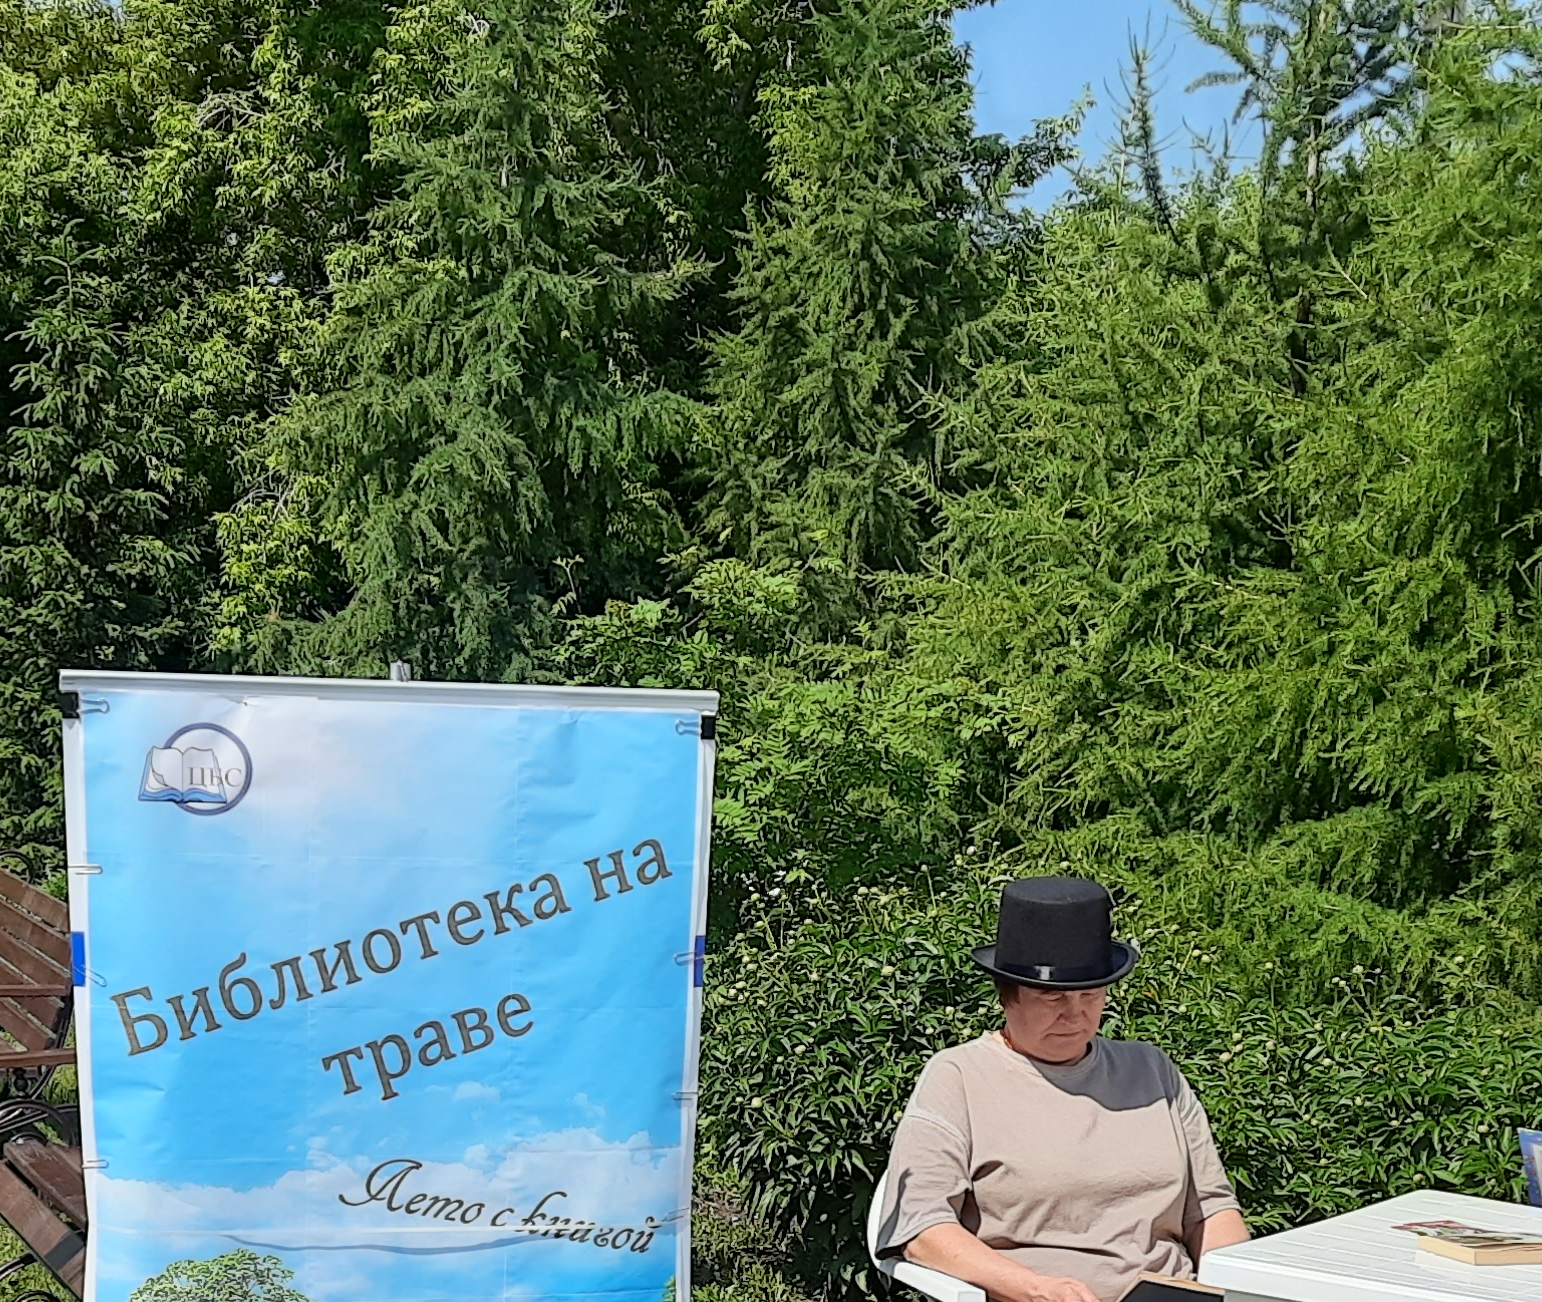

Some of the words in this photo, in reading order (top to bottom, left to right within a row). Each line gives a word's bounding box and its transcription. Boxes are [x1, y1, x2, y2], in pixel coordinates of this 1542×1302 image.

[110, 870, 572, 1056] Библиотека
[583, 838, 673, 902] на
[322, 992, 535, 1100] траве
[339, 1158, 485, 1225] Лето
[490, 1207, 515, 1227] с
